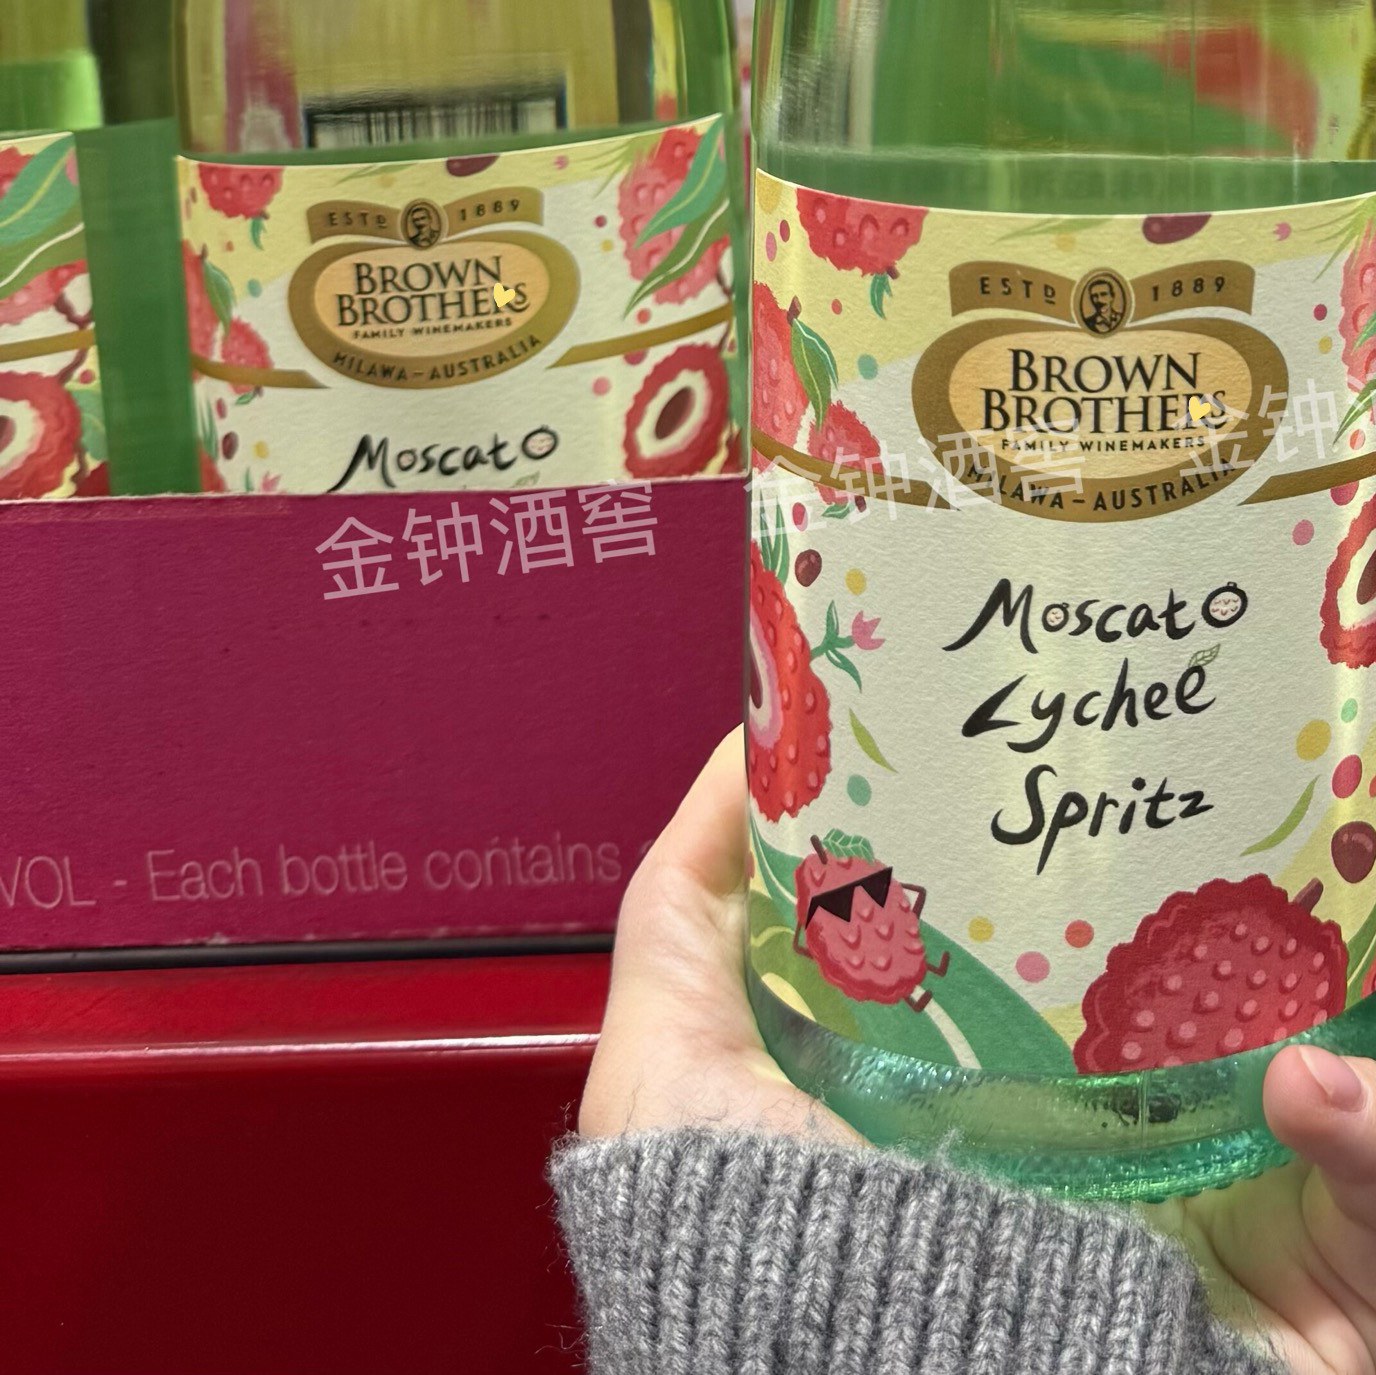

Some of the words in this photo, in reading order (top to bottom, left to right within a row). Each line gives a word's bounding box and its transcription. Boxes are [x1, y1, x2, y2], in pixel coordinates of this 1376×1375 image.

[459, 198, 520, 222] 1889
[353, 255, 502, 296] BROWN
[980, 276, 1056, 305] ESTD
[1152, 275, 1227, 303] 1889
[352, 327, 405, 340] FAMILY
[411, 316, 513, 336] WINEMAKERS
[1008, 348, 1203, 393] BROWN
[324, 424, 559, 494] Moscato
[1001, 437, 1070, 452] FAMILY
[1081, 435, 1206, 453] WINEMAKERS
[941, 578, 1249, 655] Moscato
[961, 654, 1219, 754] Lychee
[990, 763, 1214, 876] Spritz
[147, 846, 263, 902] Each
[279, 839, 408, 896] bottle
[424, 828, 623, 891] contains
